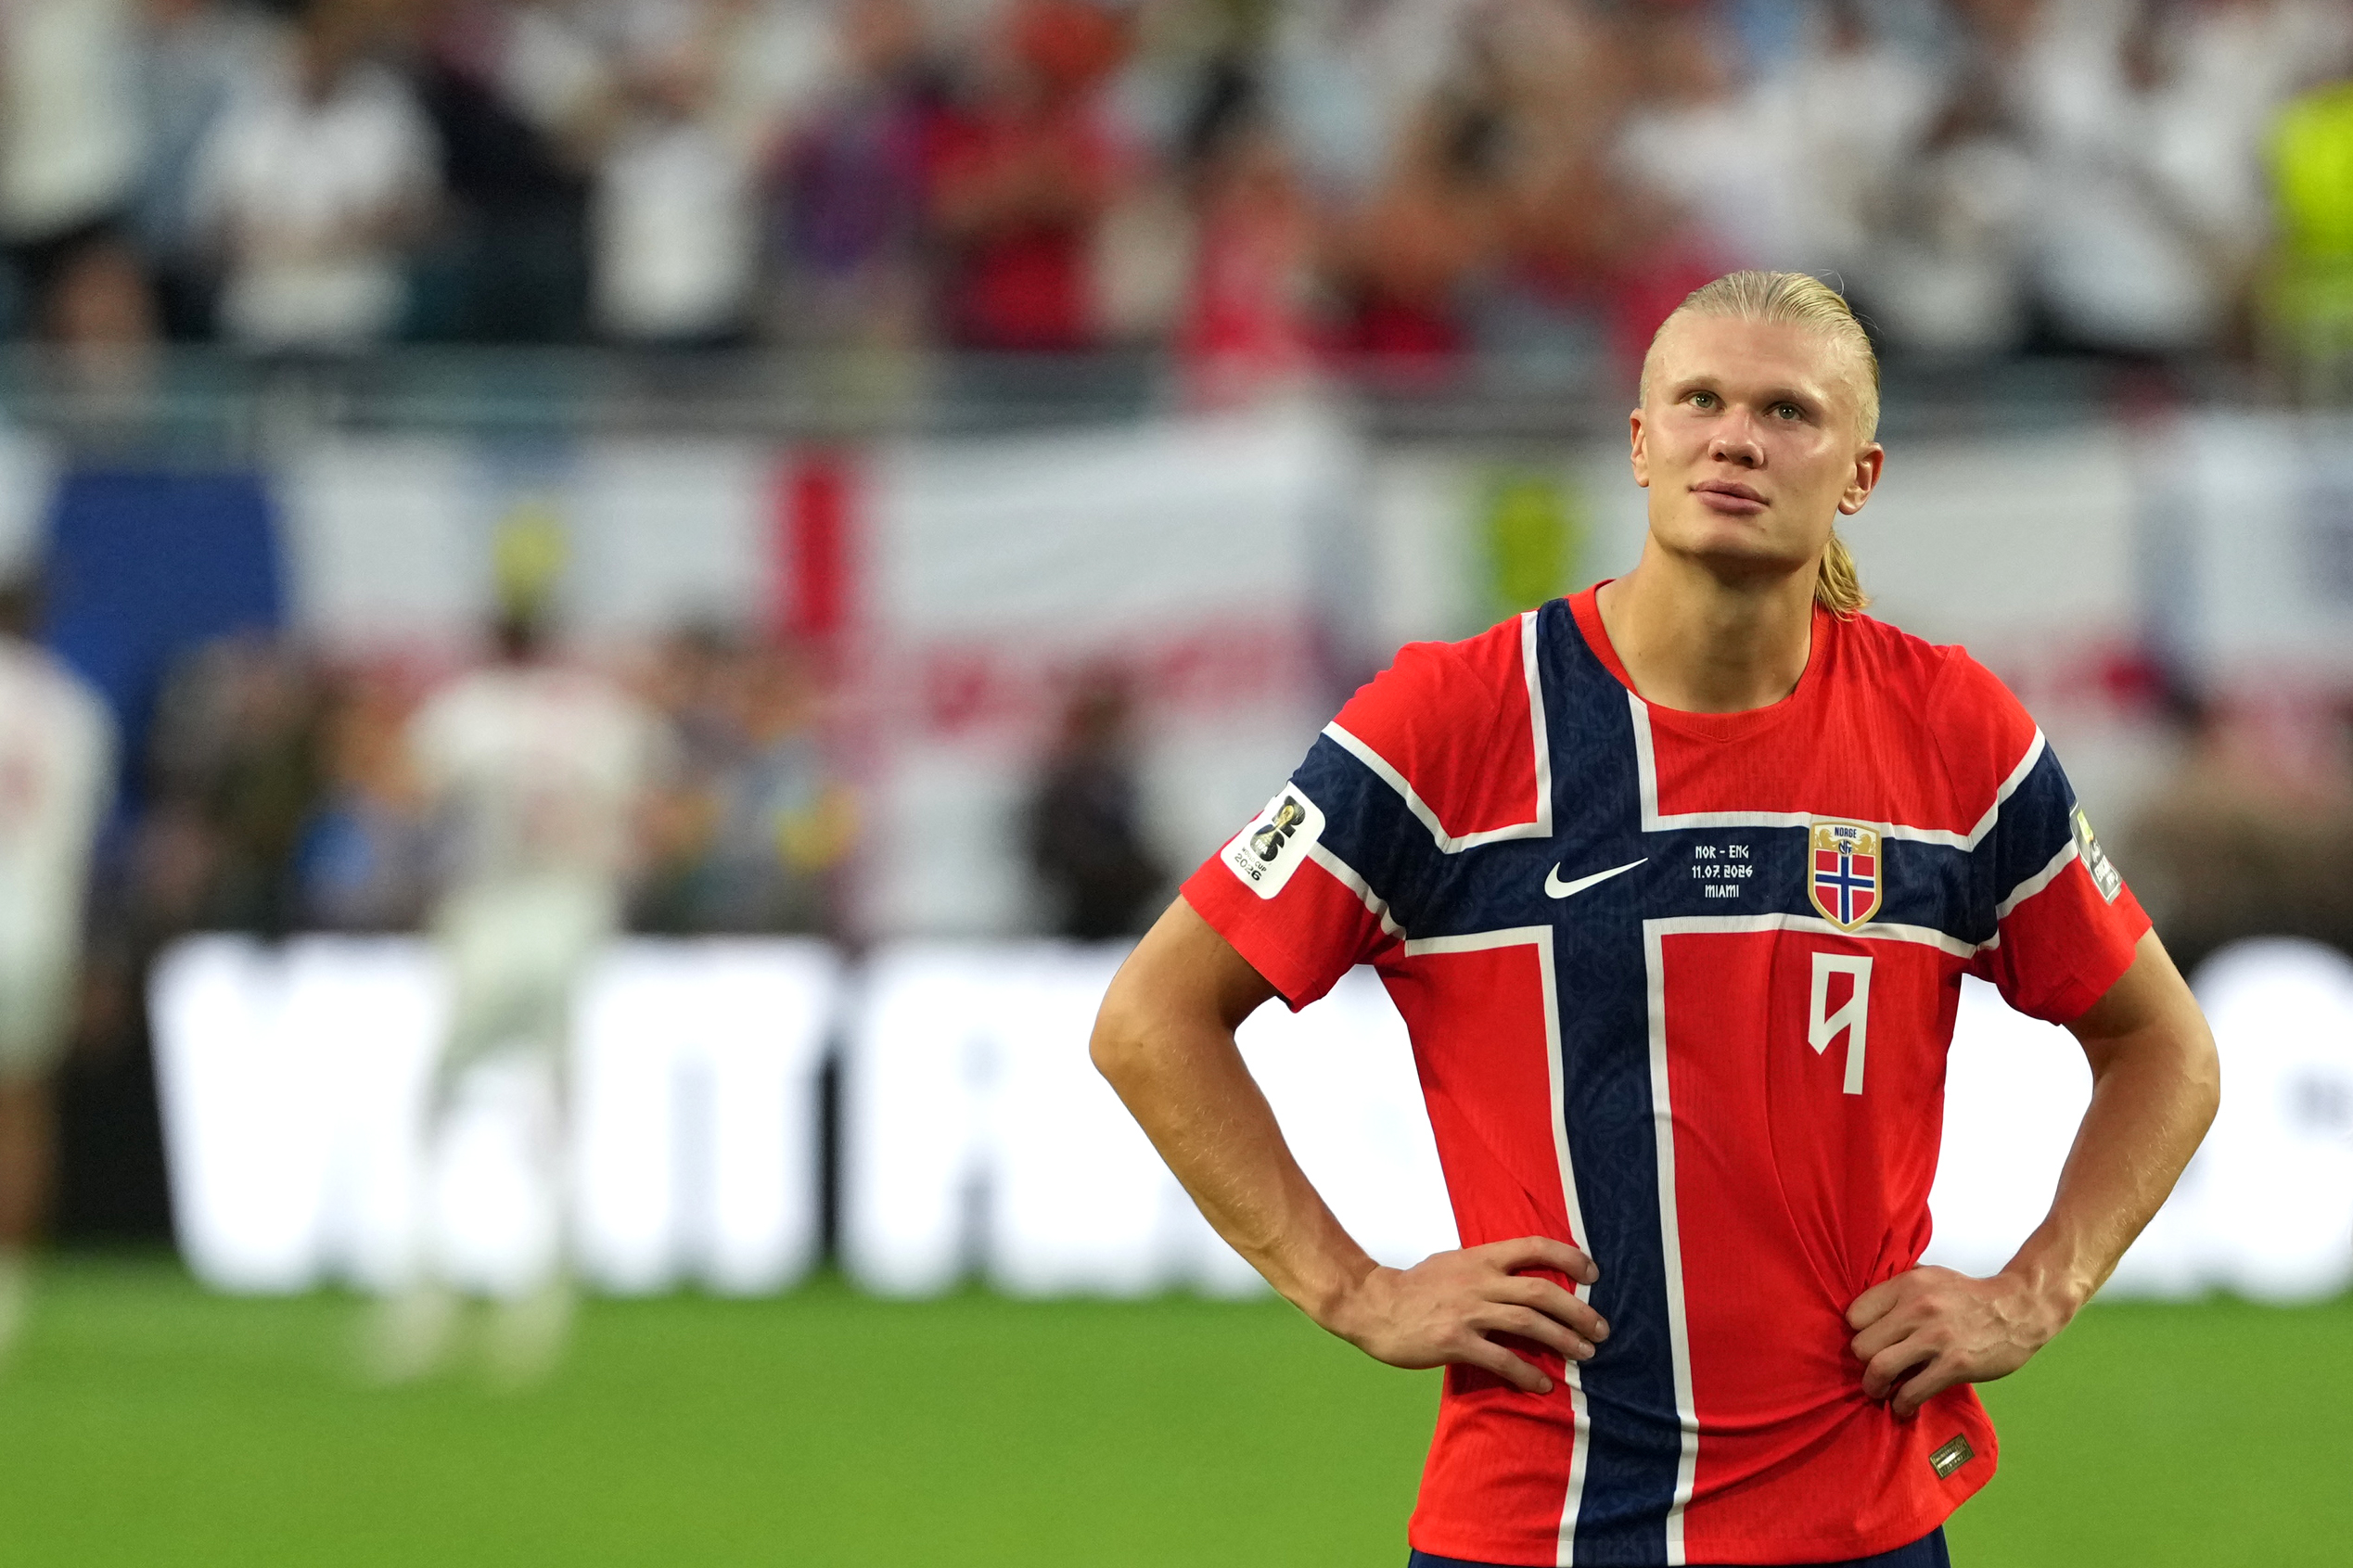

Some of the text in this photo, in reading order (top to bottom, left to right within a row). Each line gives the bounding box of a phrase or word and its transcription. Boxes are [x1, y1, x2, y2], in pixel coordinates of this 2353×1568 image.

[1835, 826, 1857, 838] NORGE
[1695, 845, 1717, 859] NOR
[1729, 845, 1749, 859] ENG
[1234, 853, 1262, 881] 2026
[1254, 860, 1268, 873] CUP
[1705, 884, 1740, 899] MIAMI
[1808, 951, 1873, 1095] 9
